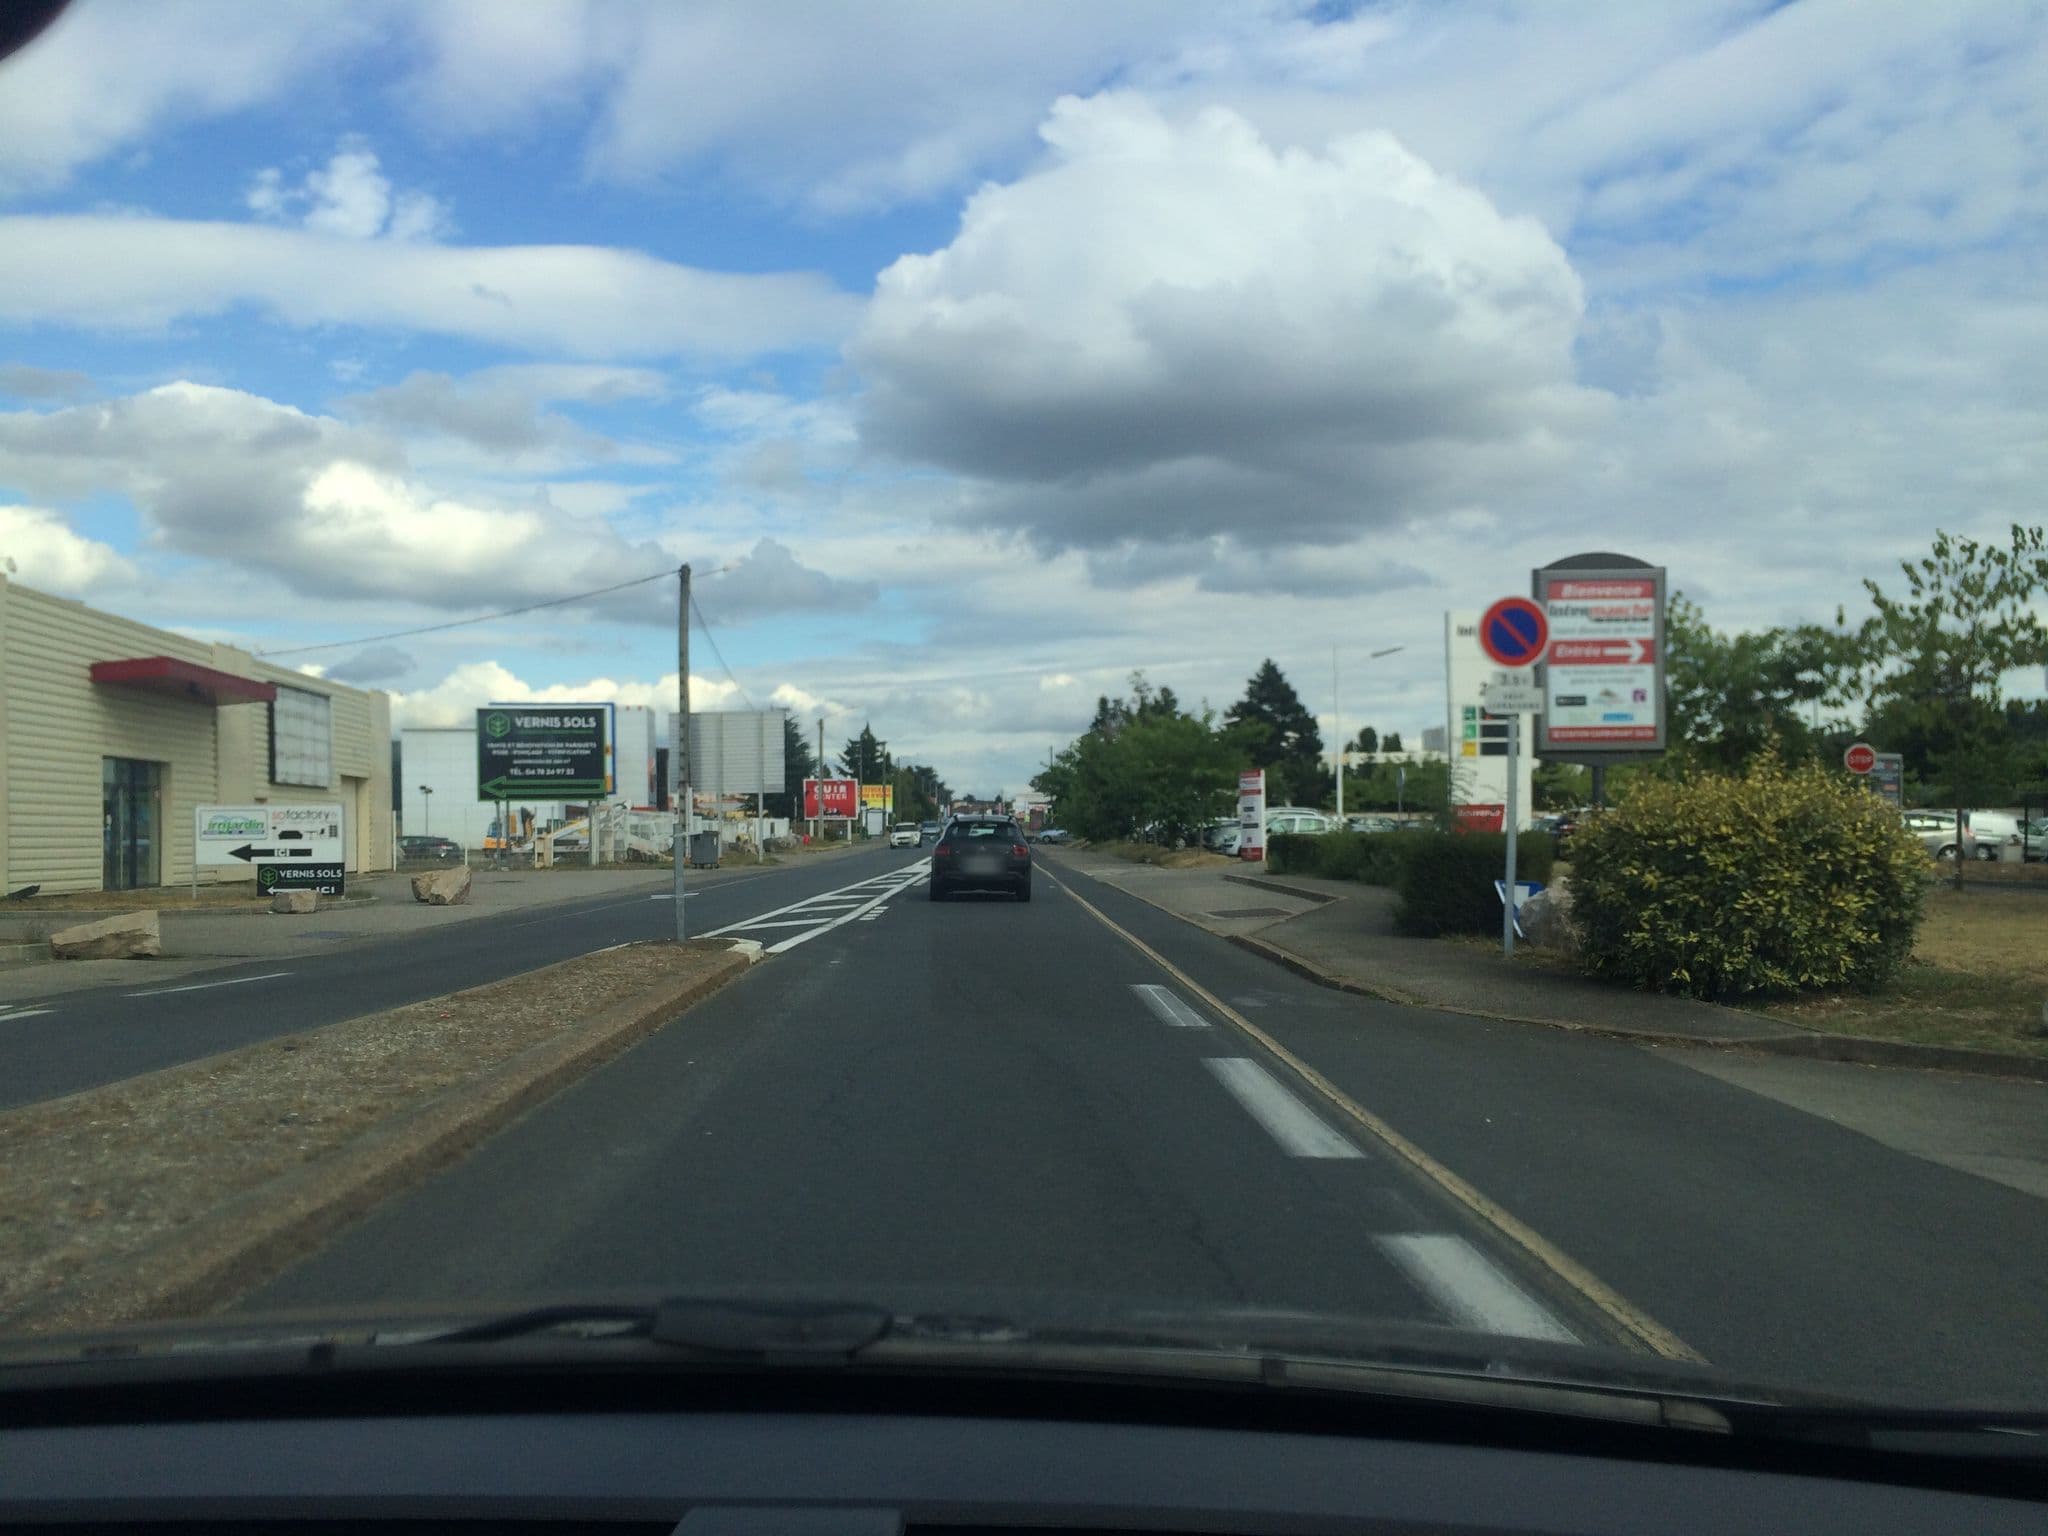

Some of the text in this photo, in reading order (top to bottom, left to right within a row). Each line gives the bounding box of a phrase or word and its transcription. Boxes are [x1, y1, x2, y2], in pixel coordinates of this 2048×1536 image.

[515, 716, 597, 728] VERNIS SOLS
[1849, 755, 1874, 764] STOP
[274, 848, 291, 857] ICI
[279, 869, 343, 878] VERNIS SOLS
[316, 886, 335, 894] ICI
